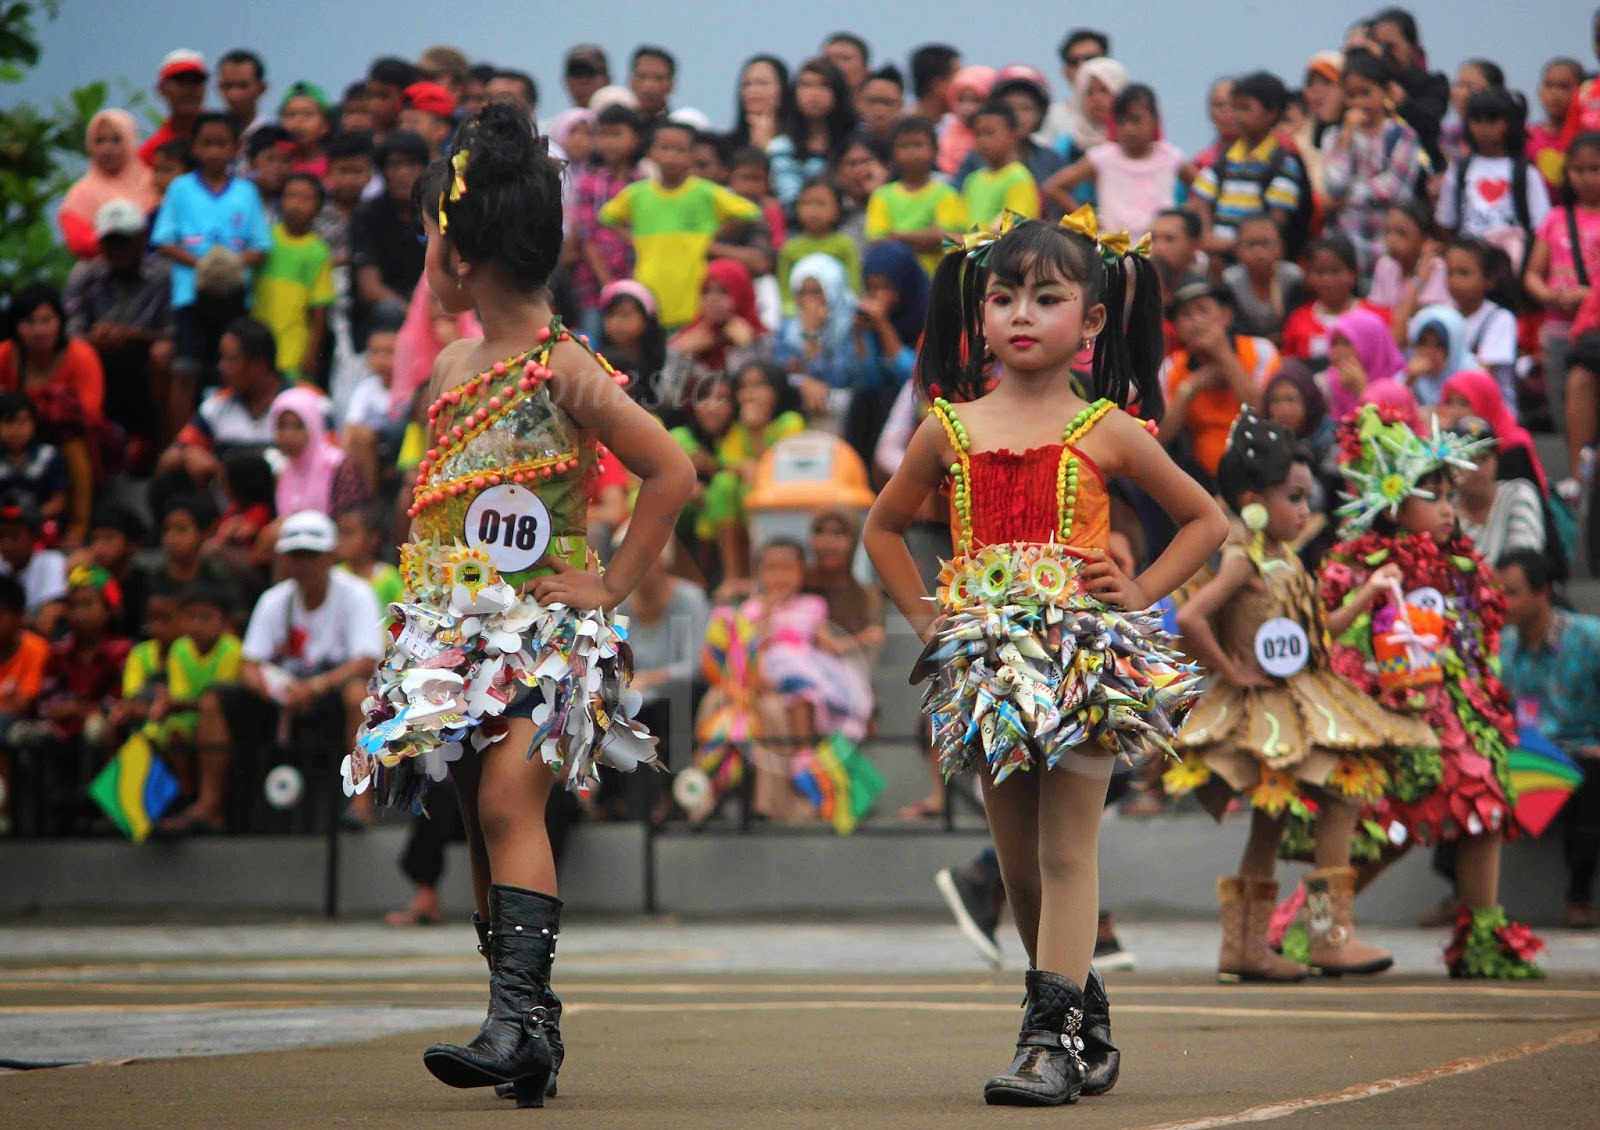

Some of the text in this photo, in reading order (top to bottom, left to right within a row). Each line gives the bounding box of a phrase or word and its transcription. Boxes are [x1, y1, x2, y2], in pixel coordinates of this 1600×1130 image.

[478, 509, 538, 551] 018
[1263, 634, 1301, 660] 020
[981, 723, 992, 735] 10
